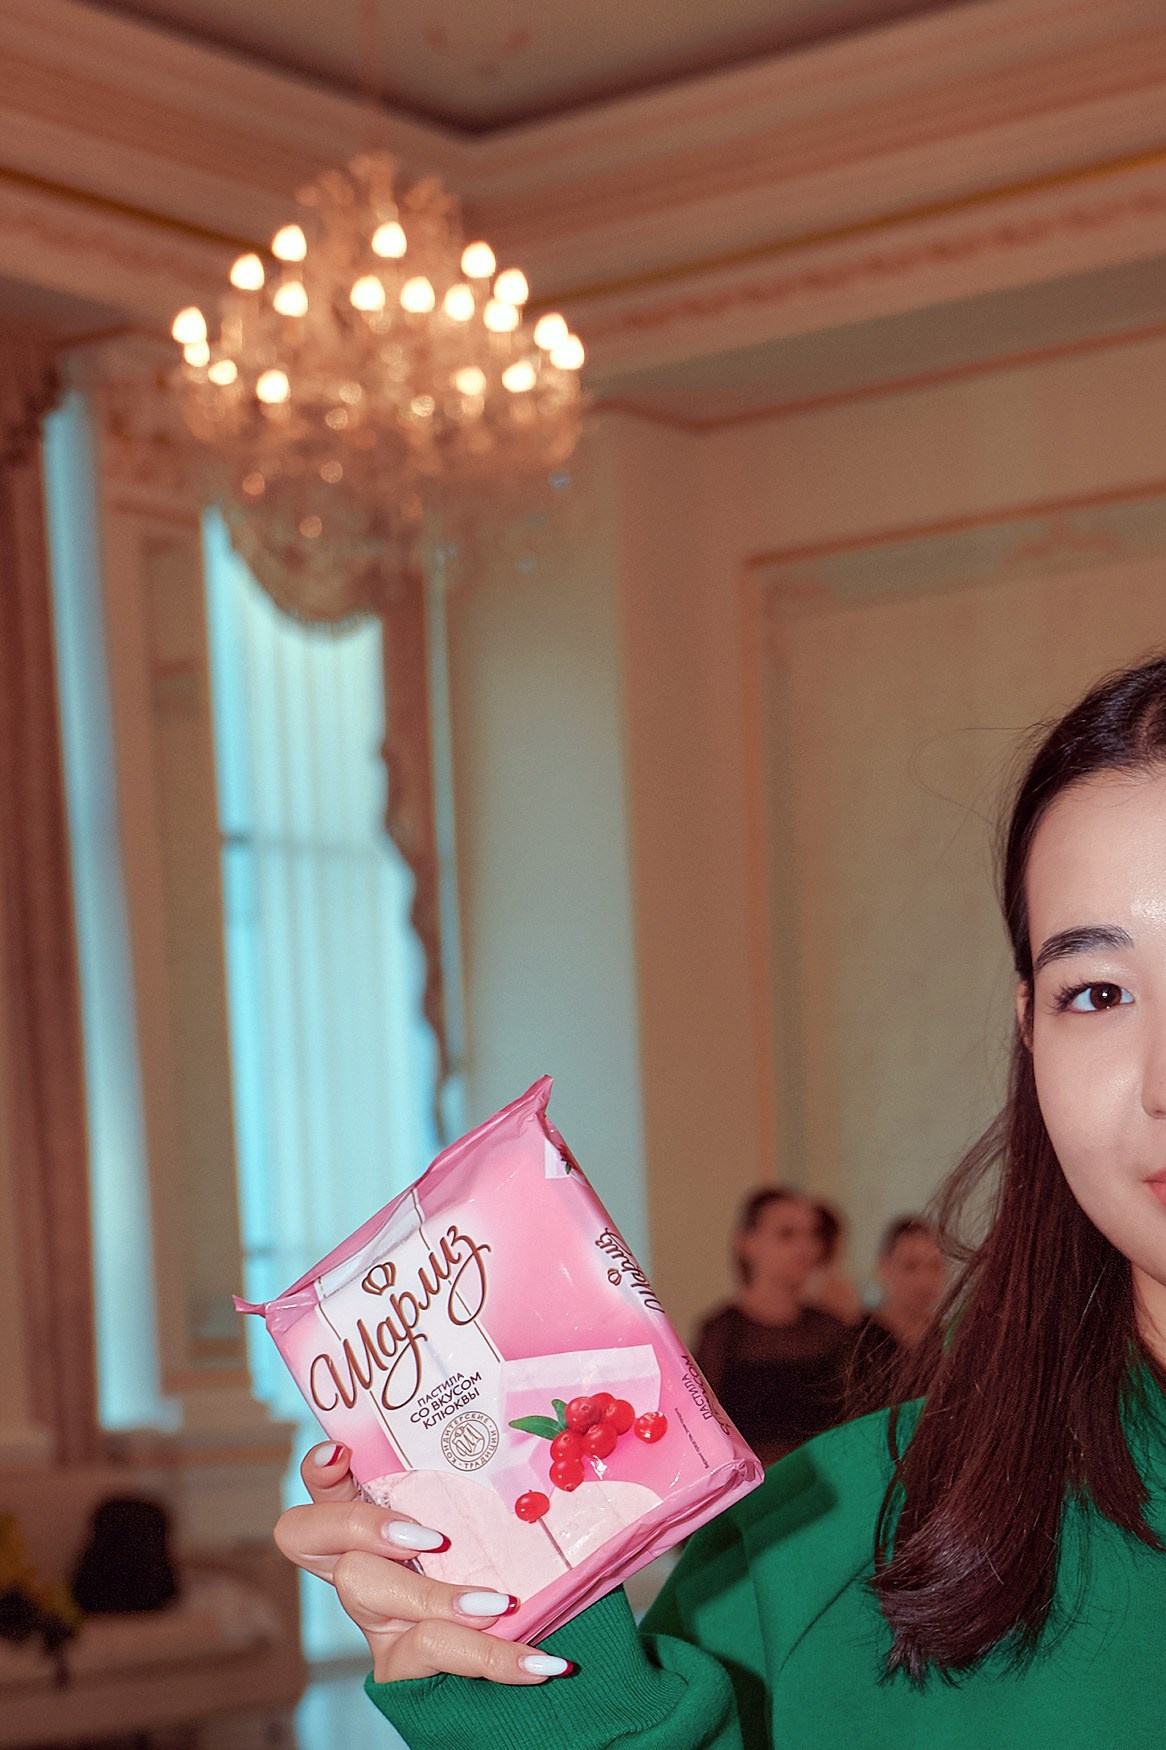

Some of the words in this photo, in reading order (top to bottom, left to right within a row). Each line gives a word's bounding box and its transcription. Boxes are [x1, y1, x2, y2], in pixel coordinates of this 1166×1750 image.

[310, 1225, 492, 1411] Шарлиз
[410, 1407, 430, 1423] СО
[430, 1371, 482, 1411] ВКУСОМ
[417, 1372, 465, 1407] ПАСТИЛА
[423, 1387, 480, 1430] КЛЮКВЫ
[682, 1373, 713, 1421] ПАСТИЛА
[443, 1413, 489, 1464] КОНДИТЕРСКИЕ
[464, 1429, 498, 1469] ТРАДИЦИИ
